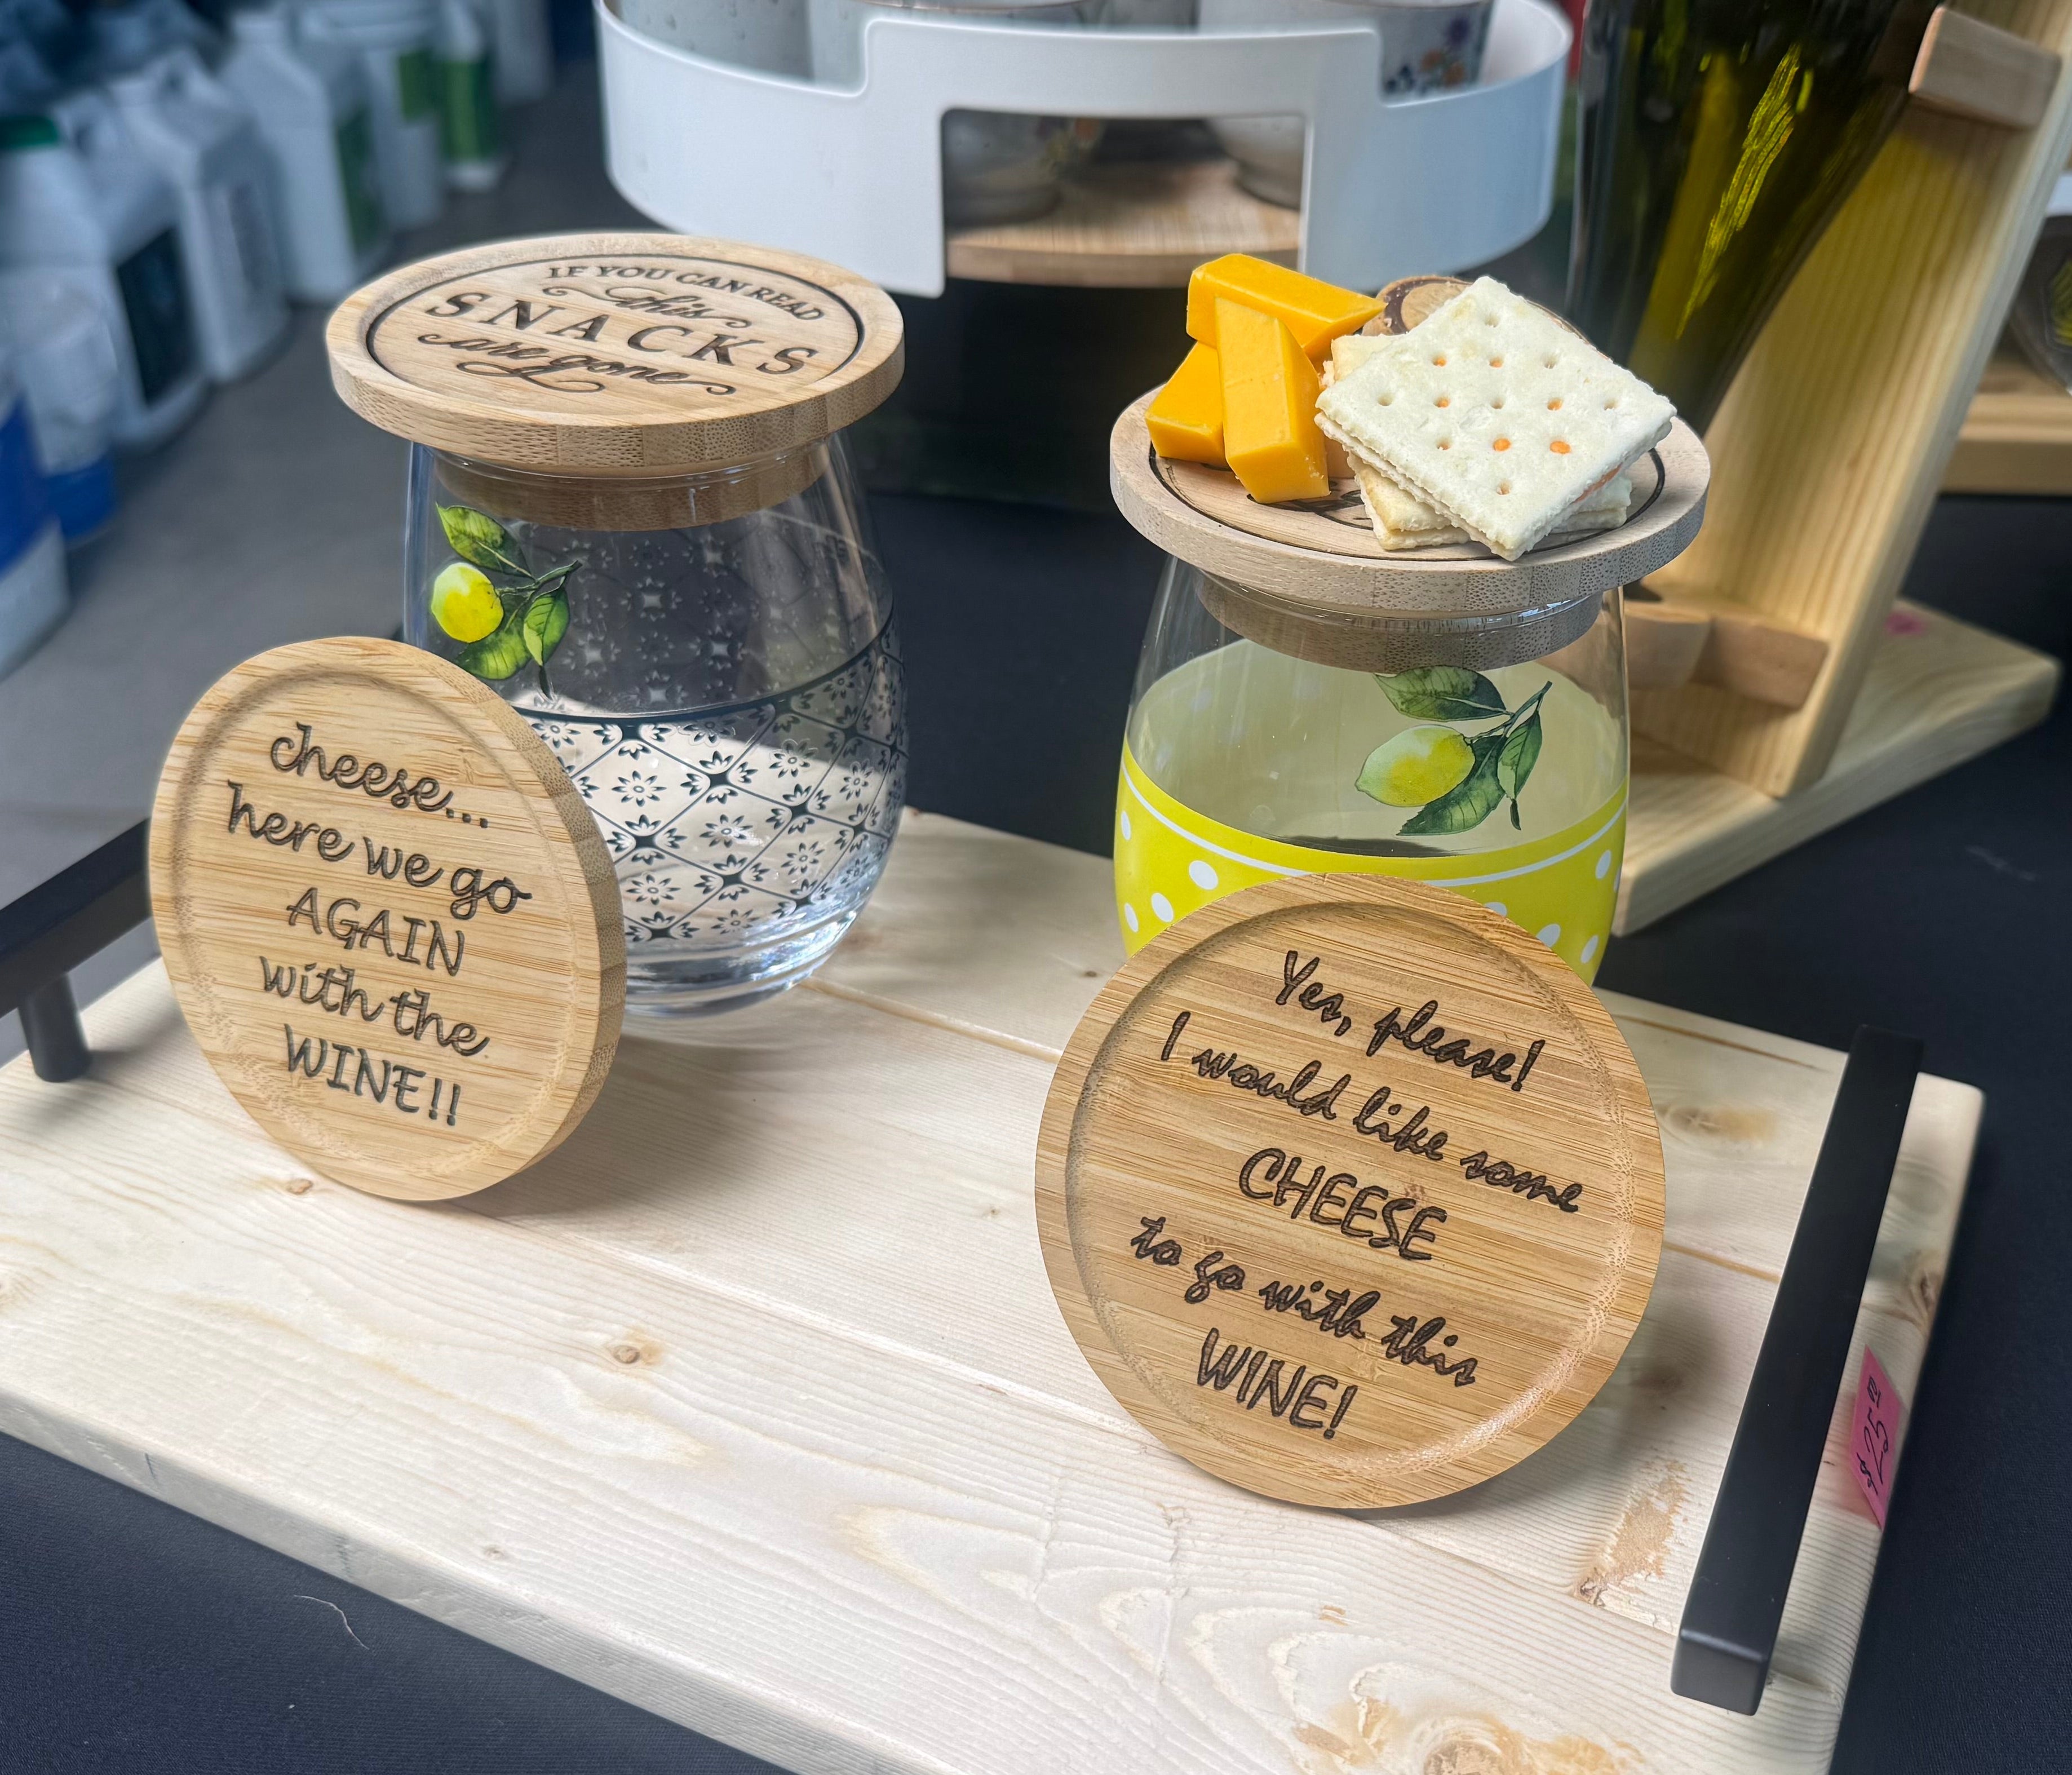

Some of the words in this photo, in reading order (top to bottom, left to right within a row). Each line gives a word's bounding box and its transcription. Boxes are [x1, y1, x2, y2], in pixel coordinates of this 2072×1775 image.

[425, 292, 818, 375] SNACKS
[543, 286, 752, 328] this
[548, 266, 586, 278] IF
[597, 266, 675, 280] YOU
[676, 273, 753, 293] CAN
[747, 287, 825, 320] READ
[418, 334, 551, 359] are
[457, 354, 736, 395] gone
[227, 779, 355, 862] here
[364, 836, 444, 888] we
[450, 866, 533, 920] go
[287, 887, 465, 977] AGAIN
[259, 955, 385, 1022] with
[389, 988, 490, 1057] the
[1276, 950, 1352, 1037] Yes,
[1366, 999, 1546, 1092] please!
[284, 1023, 461, 1126] WINE!!
[1160, 1011, 1191, 1061] I
[1191, 1047, 1352, 1121] would
[1352, 1086, 1449, 1161] like
[1460, 1150, 1583, 1213] some
[1239, 1148, 1447, 1261] CHEESE
[1131, 1216, 1183, 1265] to
[1184, 1251, 1245, 1304] go
[1259, 1280, 1381, 1340] with
[1382, 1315, 1478, 1387] this
[1197, 1327, 1358, 1439] WINE!
